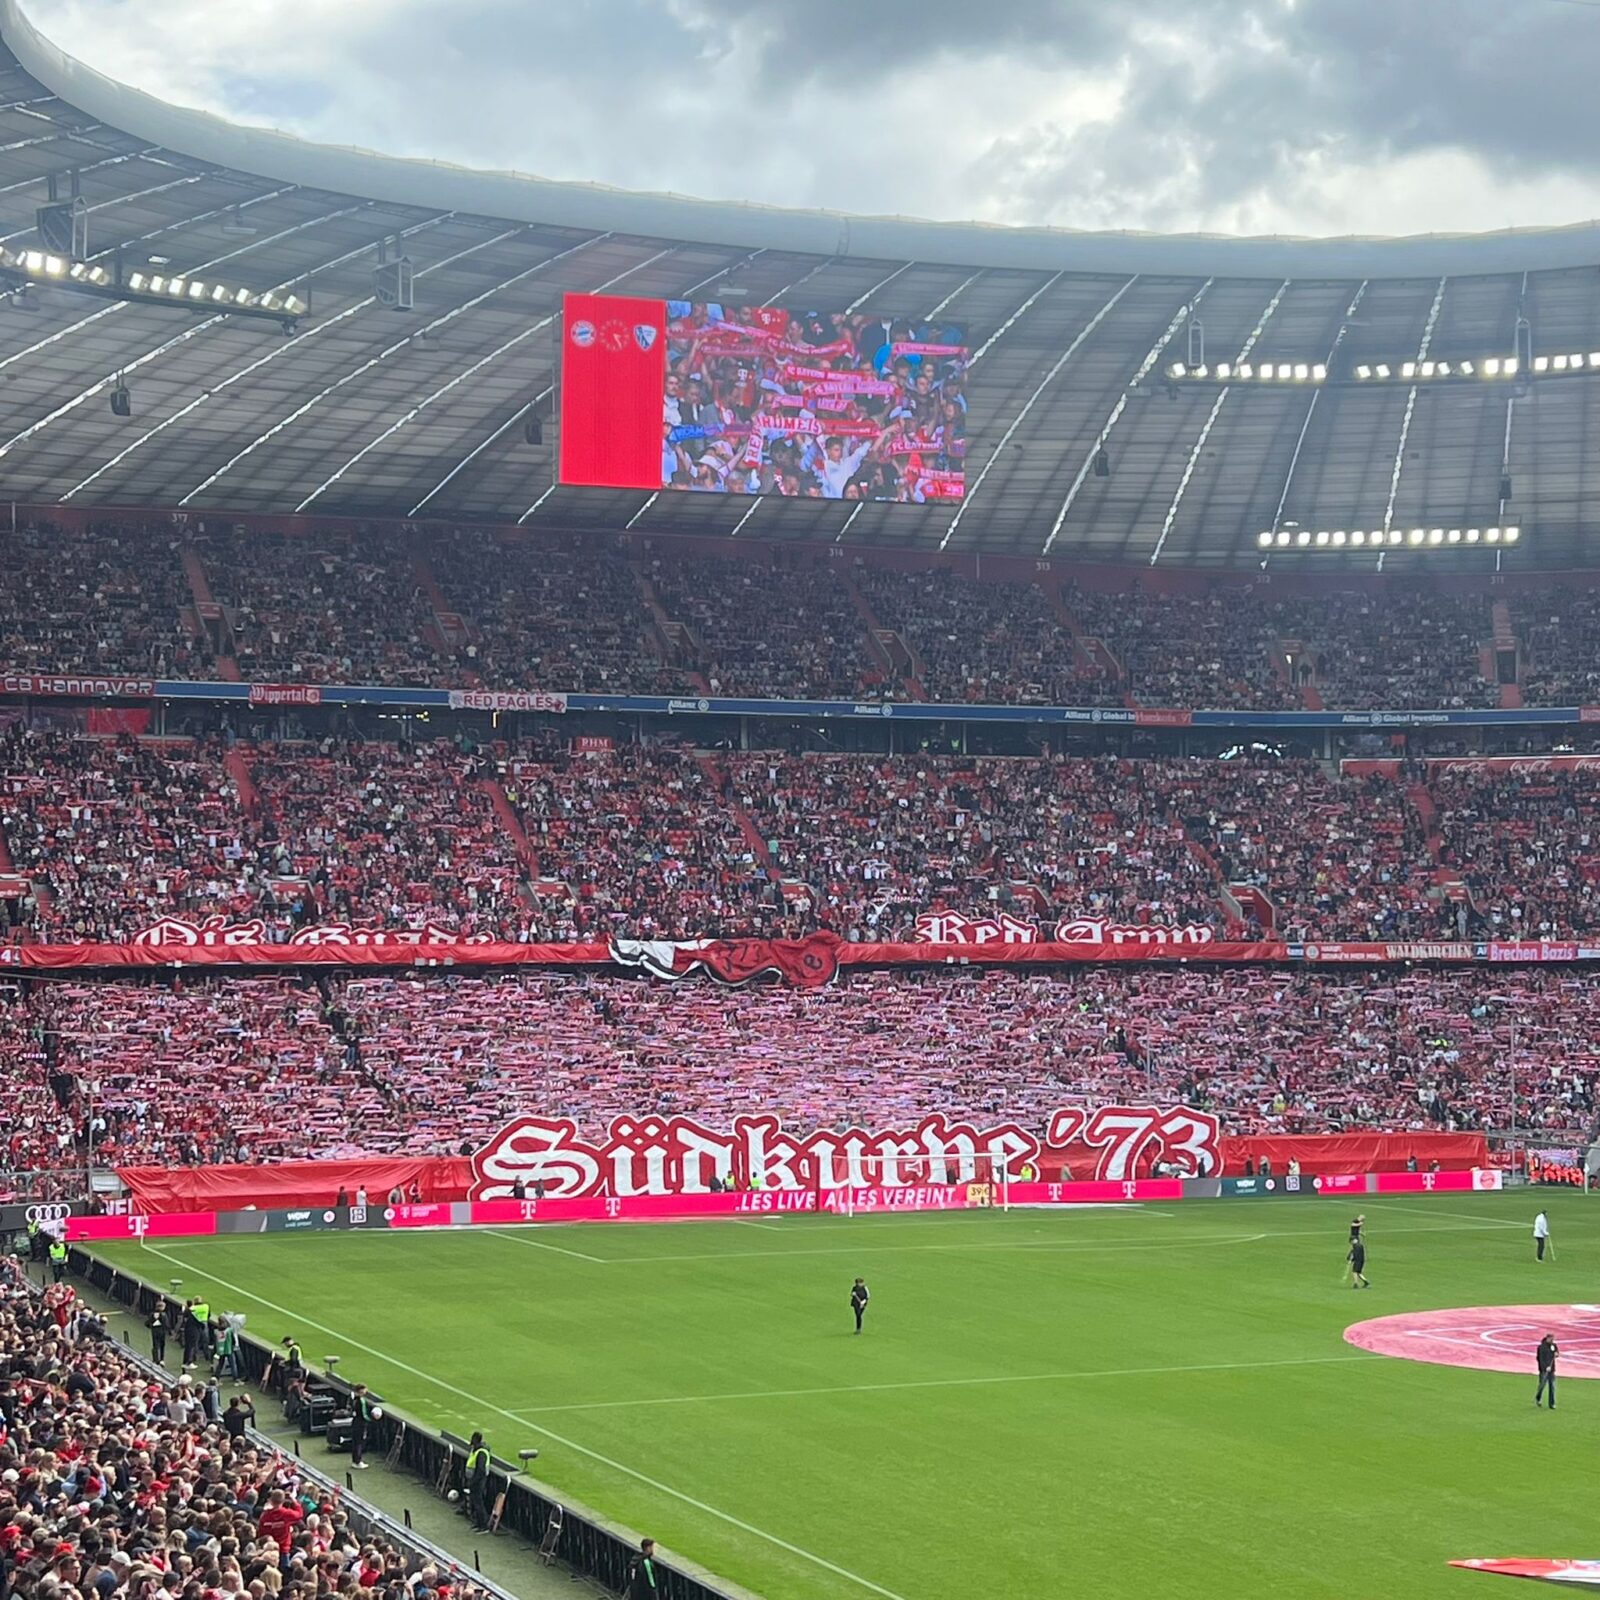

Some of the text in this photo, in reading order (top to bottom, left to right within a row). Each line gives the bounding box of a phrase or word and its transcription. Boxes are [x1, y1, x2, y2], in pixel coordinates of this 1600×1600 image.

[464, 695, 553, 708] RED EAGLES
[1383, 714, 1410, 723] Global
[1411, 714, 1449, 723] Investors
[915, 910, 1036, 944] Red
[1491, 943, 1537, 960] Brechen
[1541, 943, 1573, 960] Bazis
[777, 1191, 816, 1210] LIVE
[883, 1187, 956, 1205] VEREINT
